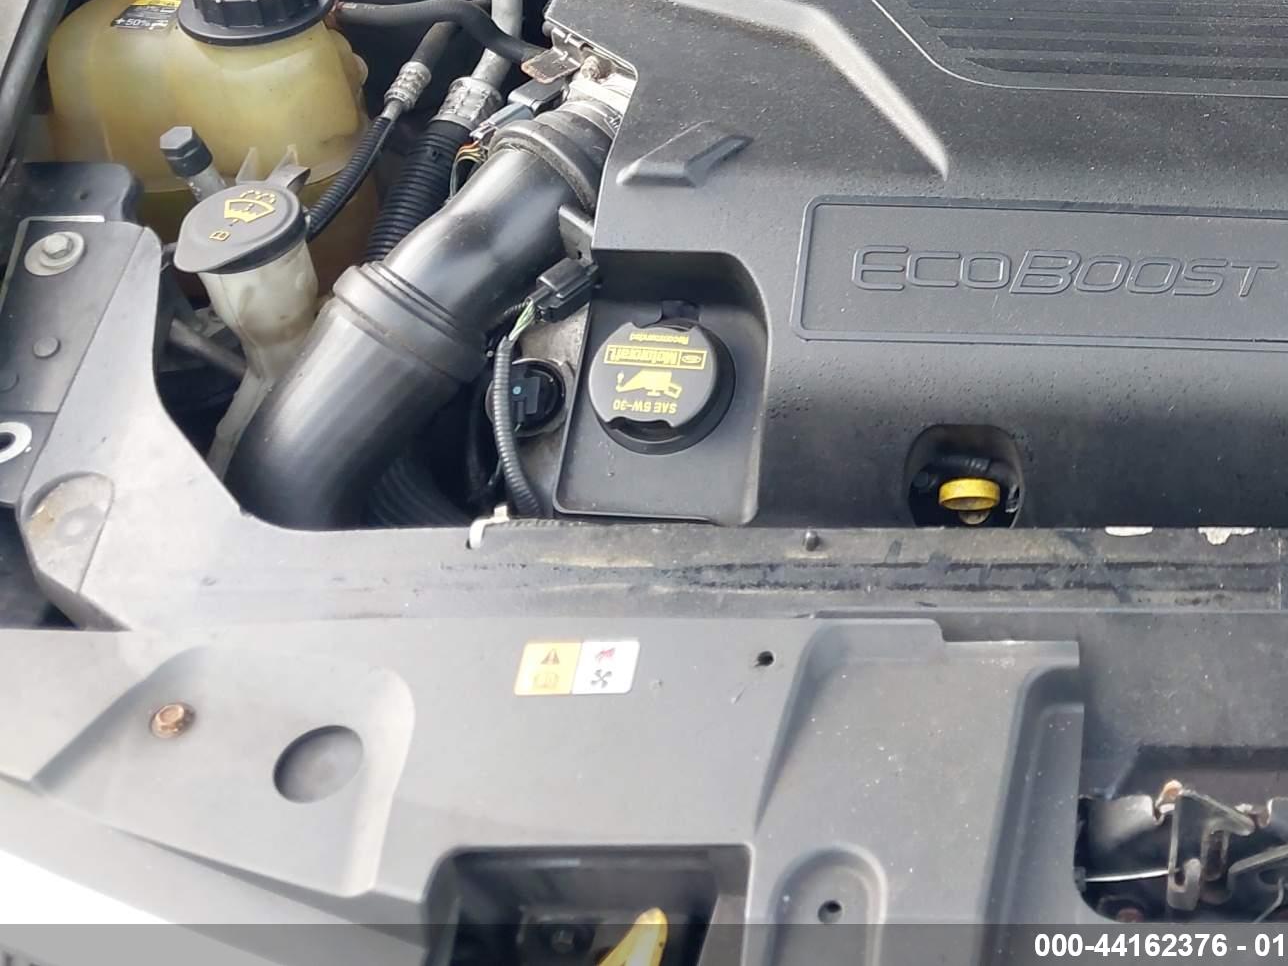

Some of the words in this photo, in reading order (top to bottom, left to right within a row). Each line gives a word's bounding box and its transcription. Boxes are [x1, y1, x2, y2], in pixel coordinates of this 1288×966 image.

[851, 244, 1280, 298] ECOBOOST
[610, 347, 678, 365] Motorcraft
[653, 401, 678, 415] SAE
